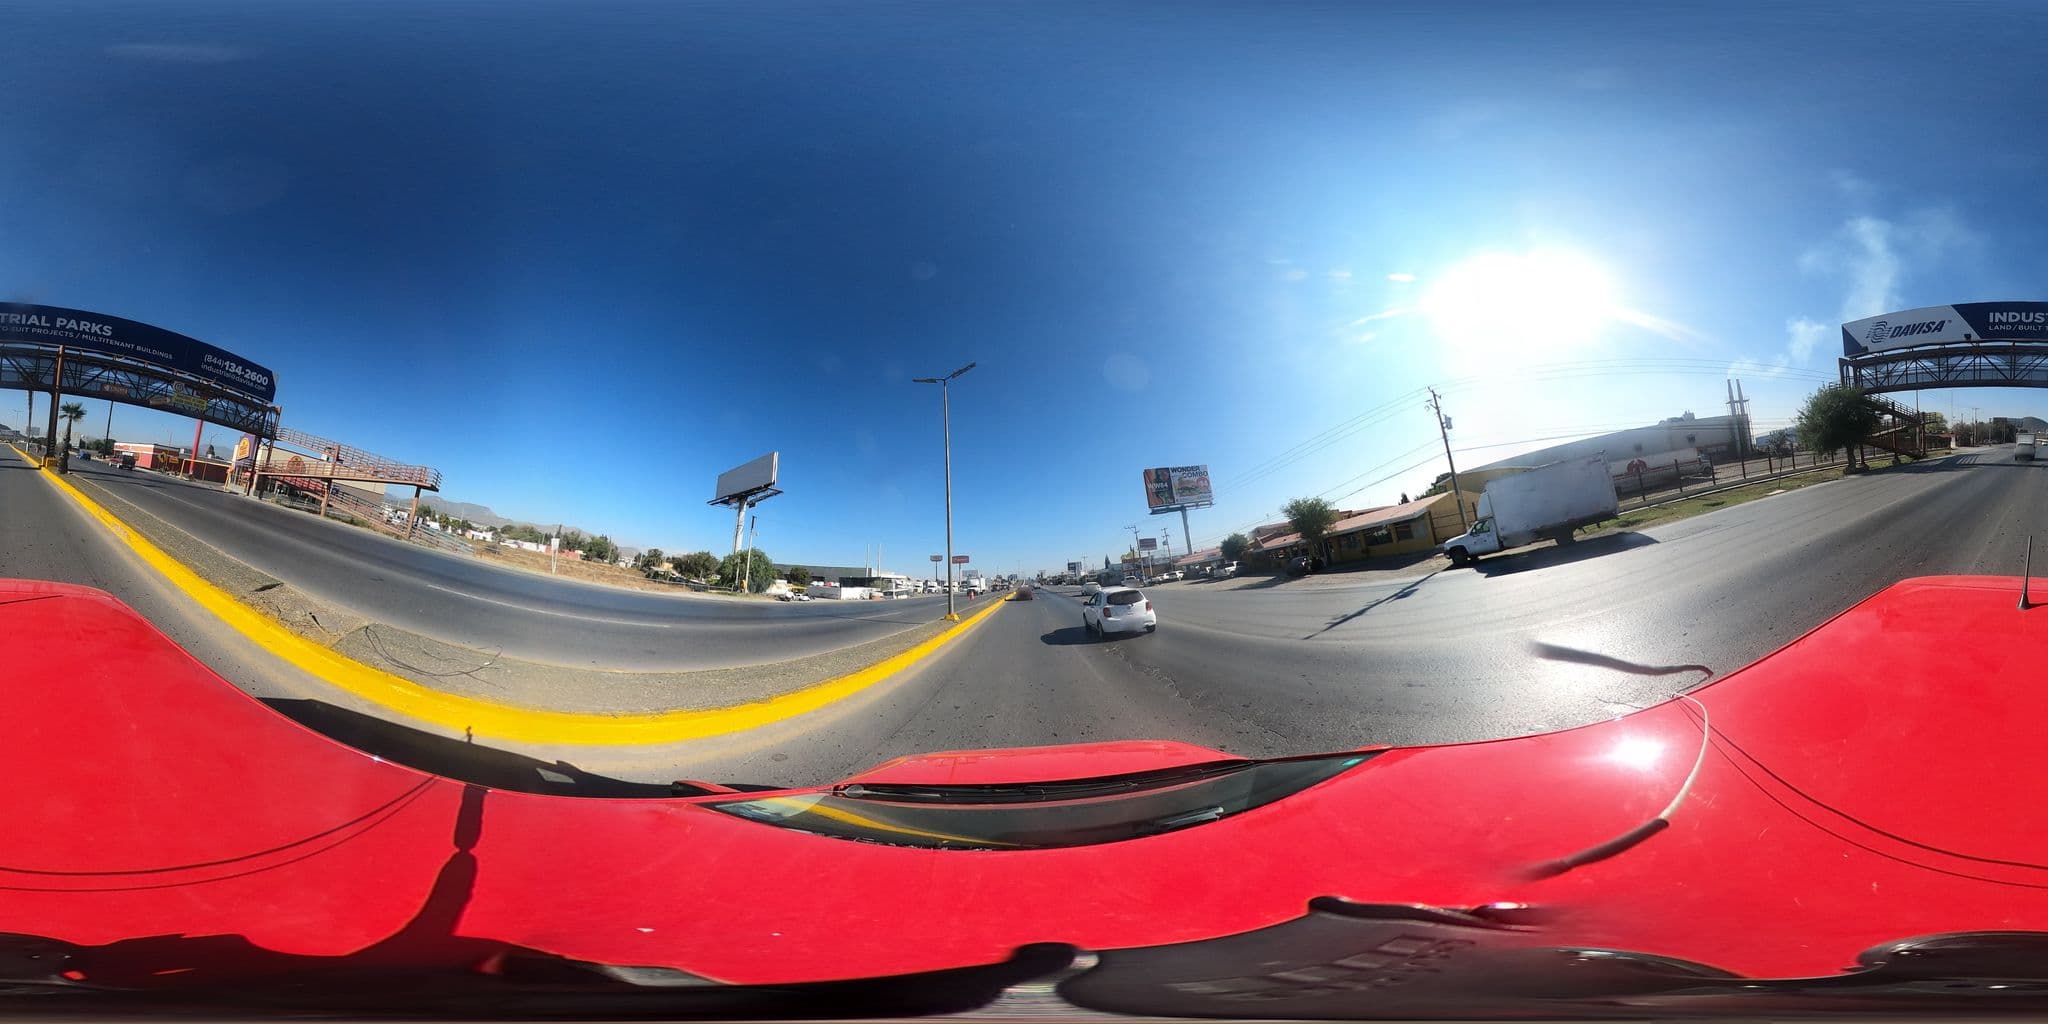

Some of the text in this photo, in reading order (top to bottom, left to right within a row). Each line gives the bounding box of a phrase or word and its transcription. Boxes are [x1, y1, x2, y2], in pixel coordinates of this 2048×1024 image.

[0, 313, 113, 336] TRIAL PARKS
[1989, 311, 2048, 323] INDUS
[1889, 320, 1946, 338] DAVISA
[31, 328, 74, 338] PROJECTS
[81, 334, 135, 349] MULTITENANT
[136, 345, 173, 360] BUILDINGS
[1170, 465, 1199, 473] WONDER
